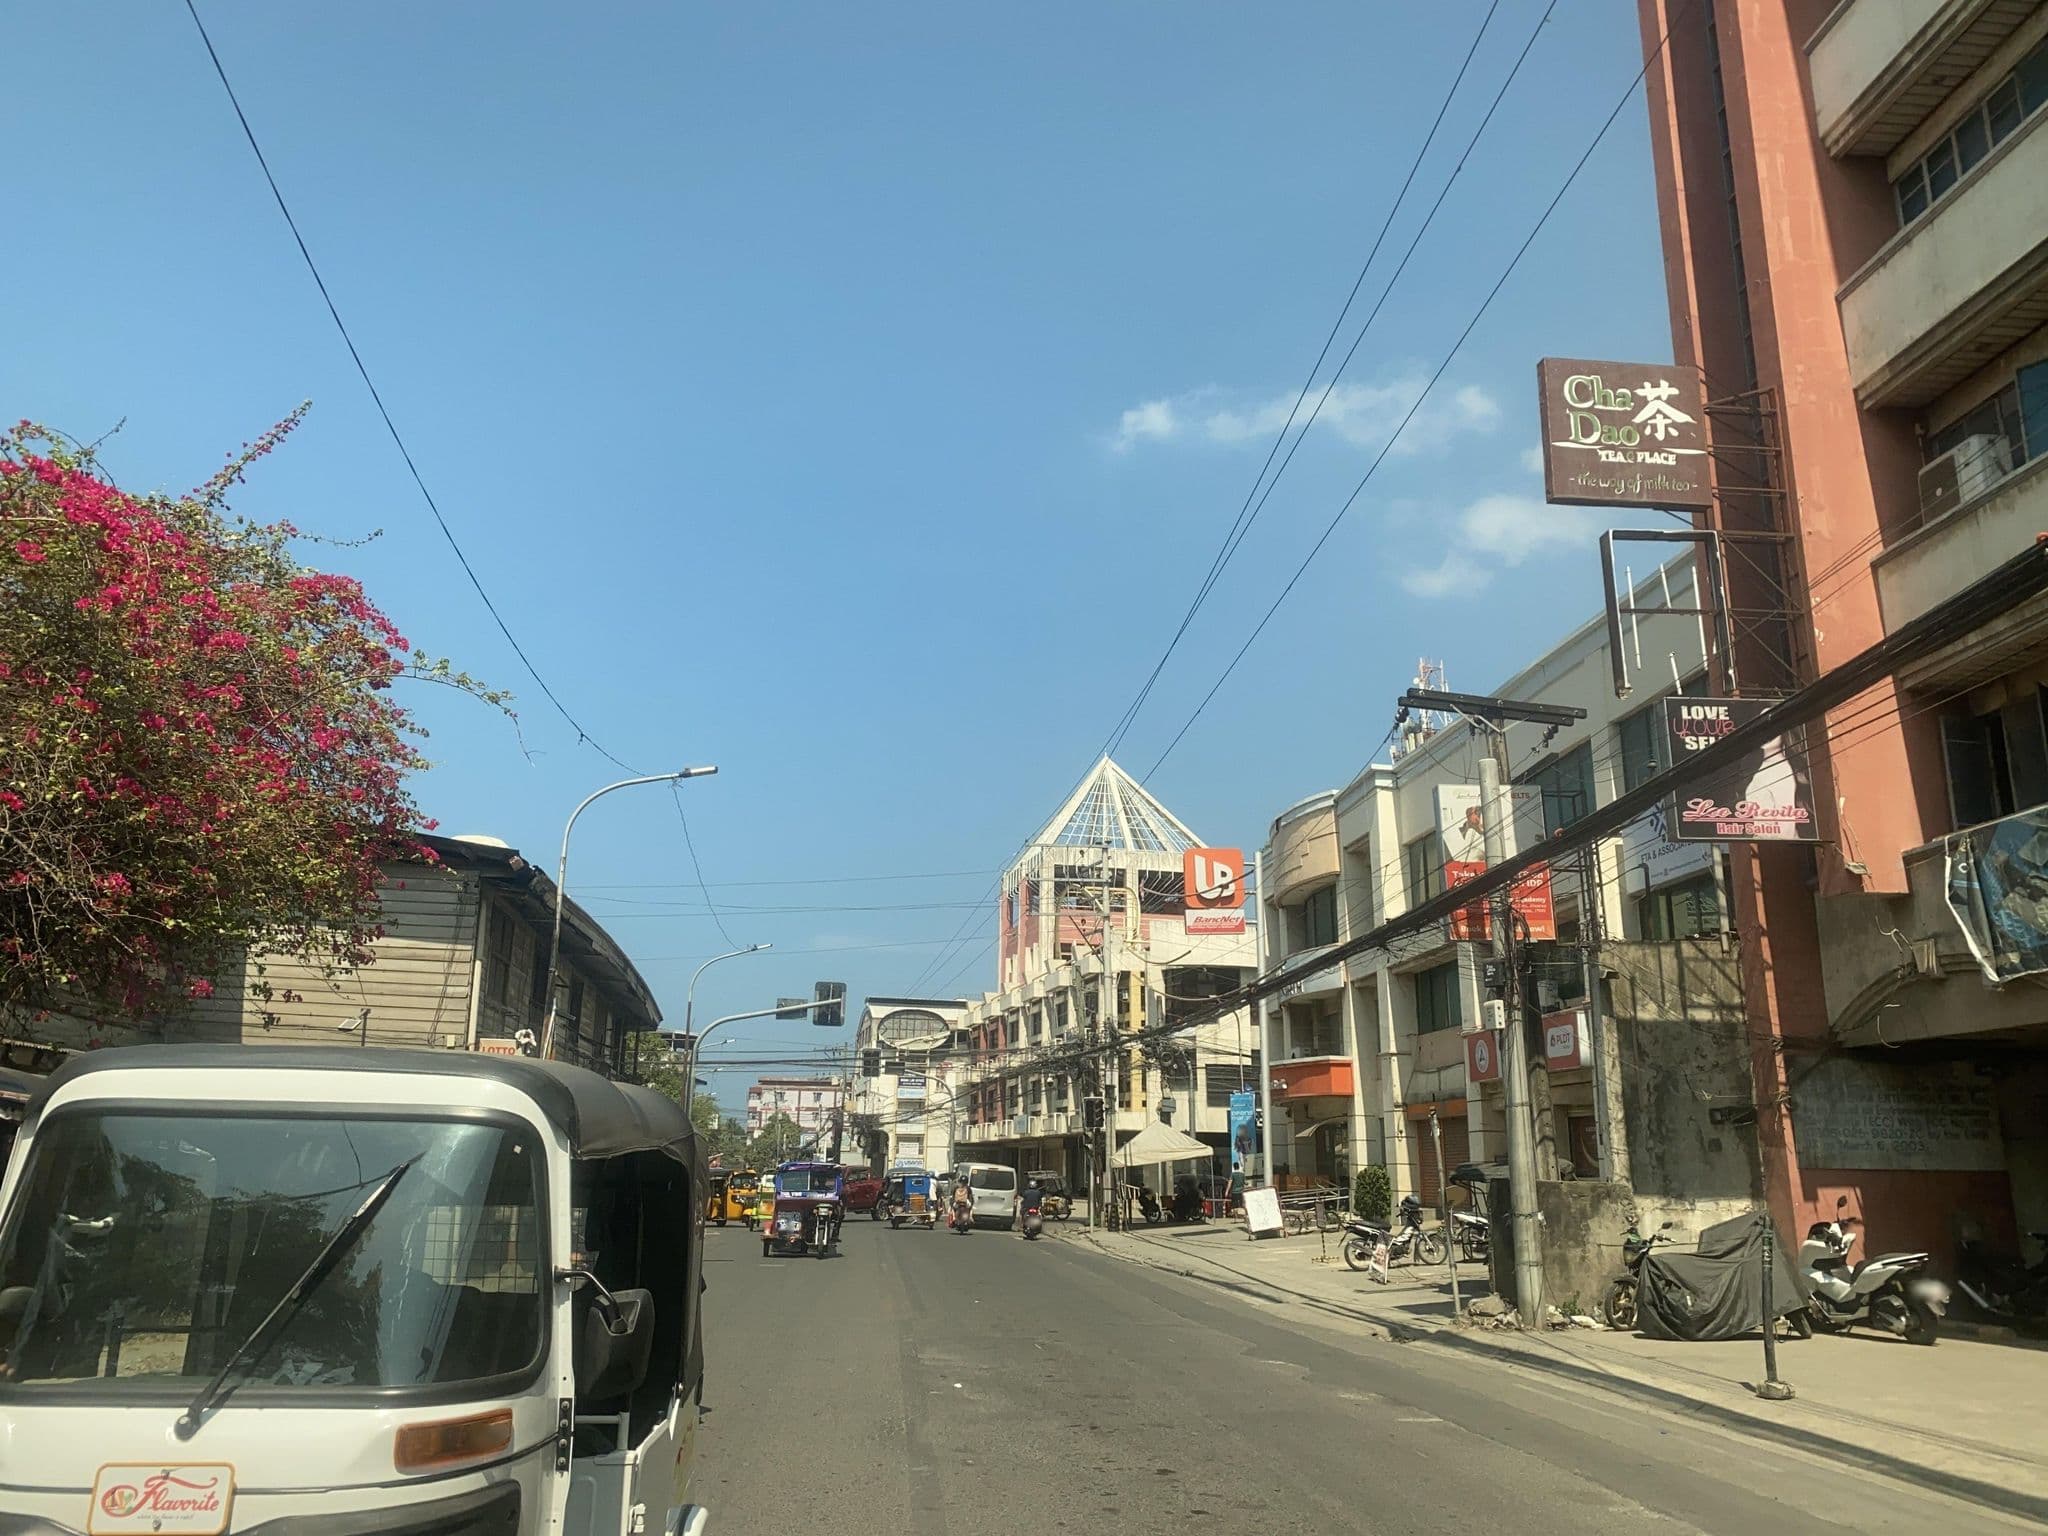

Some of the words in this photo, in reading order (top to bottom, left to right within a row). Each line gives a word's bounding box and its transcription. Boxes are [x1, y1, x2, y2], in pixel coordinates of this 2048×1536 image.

[1564, 375, 1634, 411] Cha
[1632, 379, 1698, 441] 茶
[1566, 408, 1640, 446] Dao
[1597, 449, 1625, 463] TEA
[1636, 451, 1677, 465] PLACE
[1599, 479, 1625, 495] way
[1627, 473, 1641, 494] of
[1681, 705, 1730, 721] LOVE
[1685, 736, 1722, 750] SE
[1716, 822, 1744, 835] Hair
[1745, 822, 1782, 835] Salon
[1527, 879, 1544, 888] IDP
[1556, 1033, 1570, 1045] PLDT
